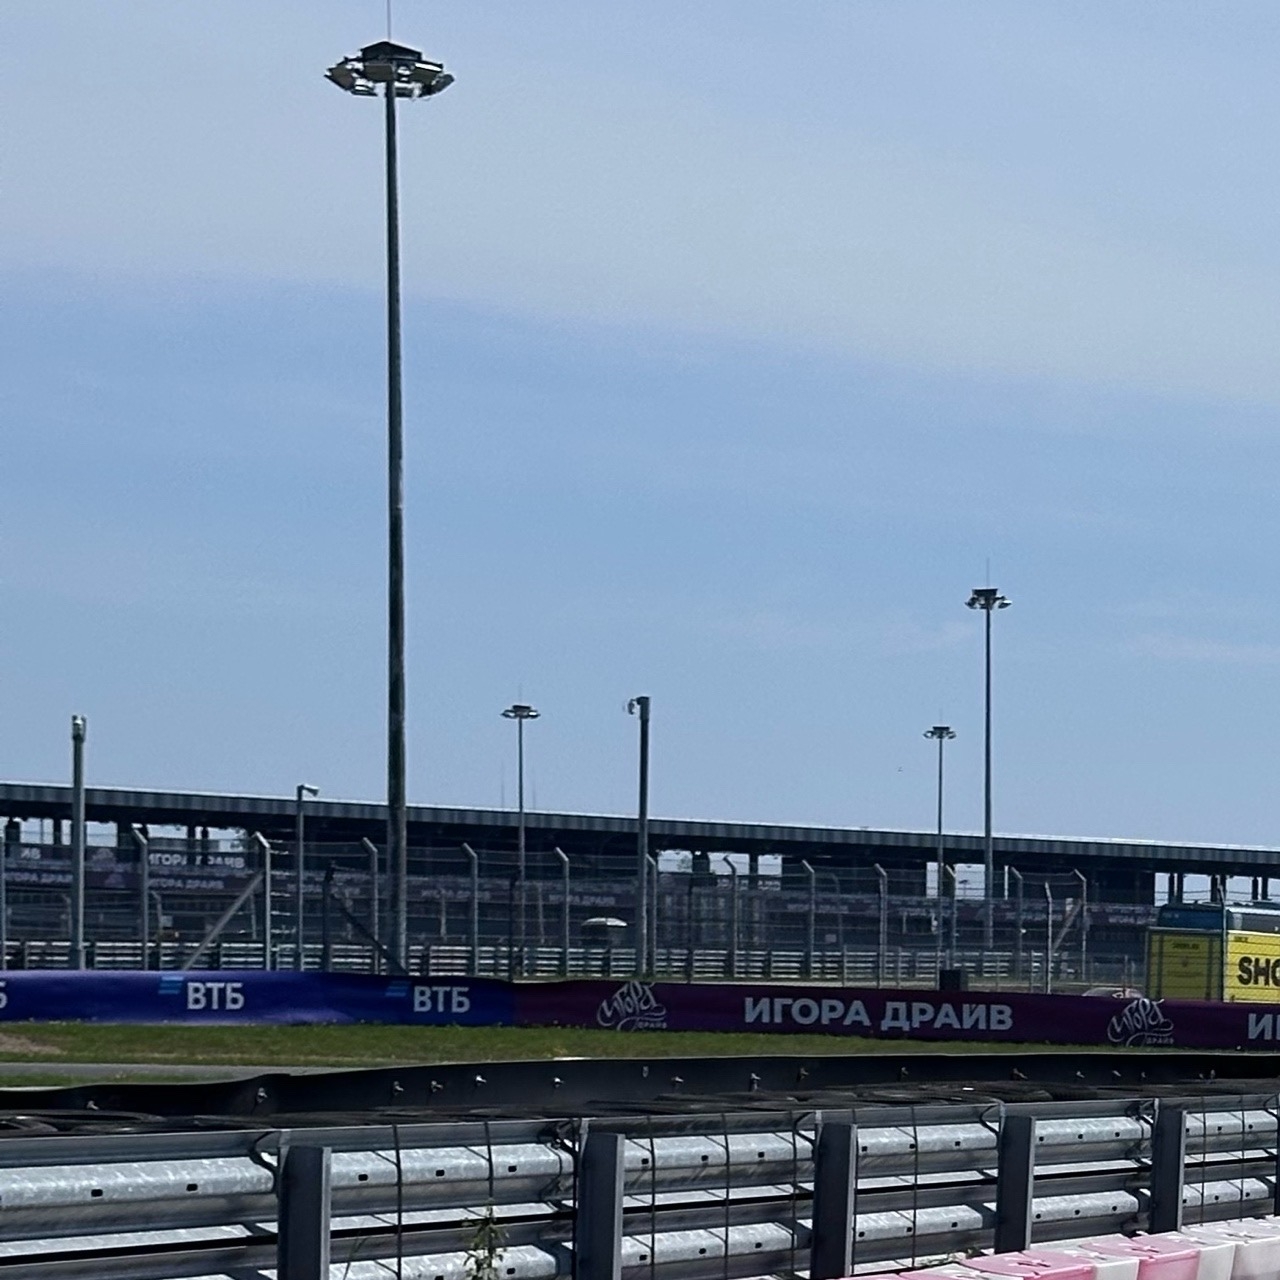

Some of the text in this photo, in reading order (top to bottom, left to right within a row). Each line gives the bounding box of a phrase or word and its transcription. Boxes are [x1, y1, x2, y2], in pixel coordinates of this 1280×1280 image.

[187, 982, 245, 1010] ВТБ
[413, 985, 471, 1013] ВТБ
[744, 997, 1014, 1031] ИГОРА ДРАЙВ
